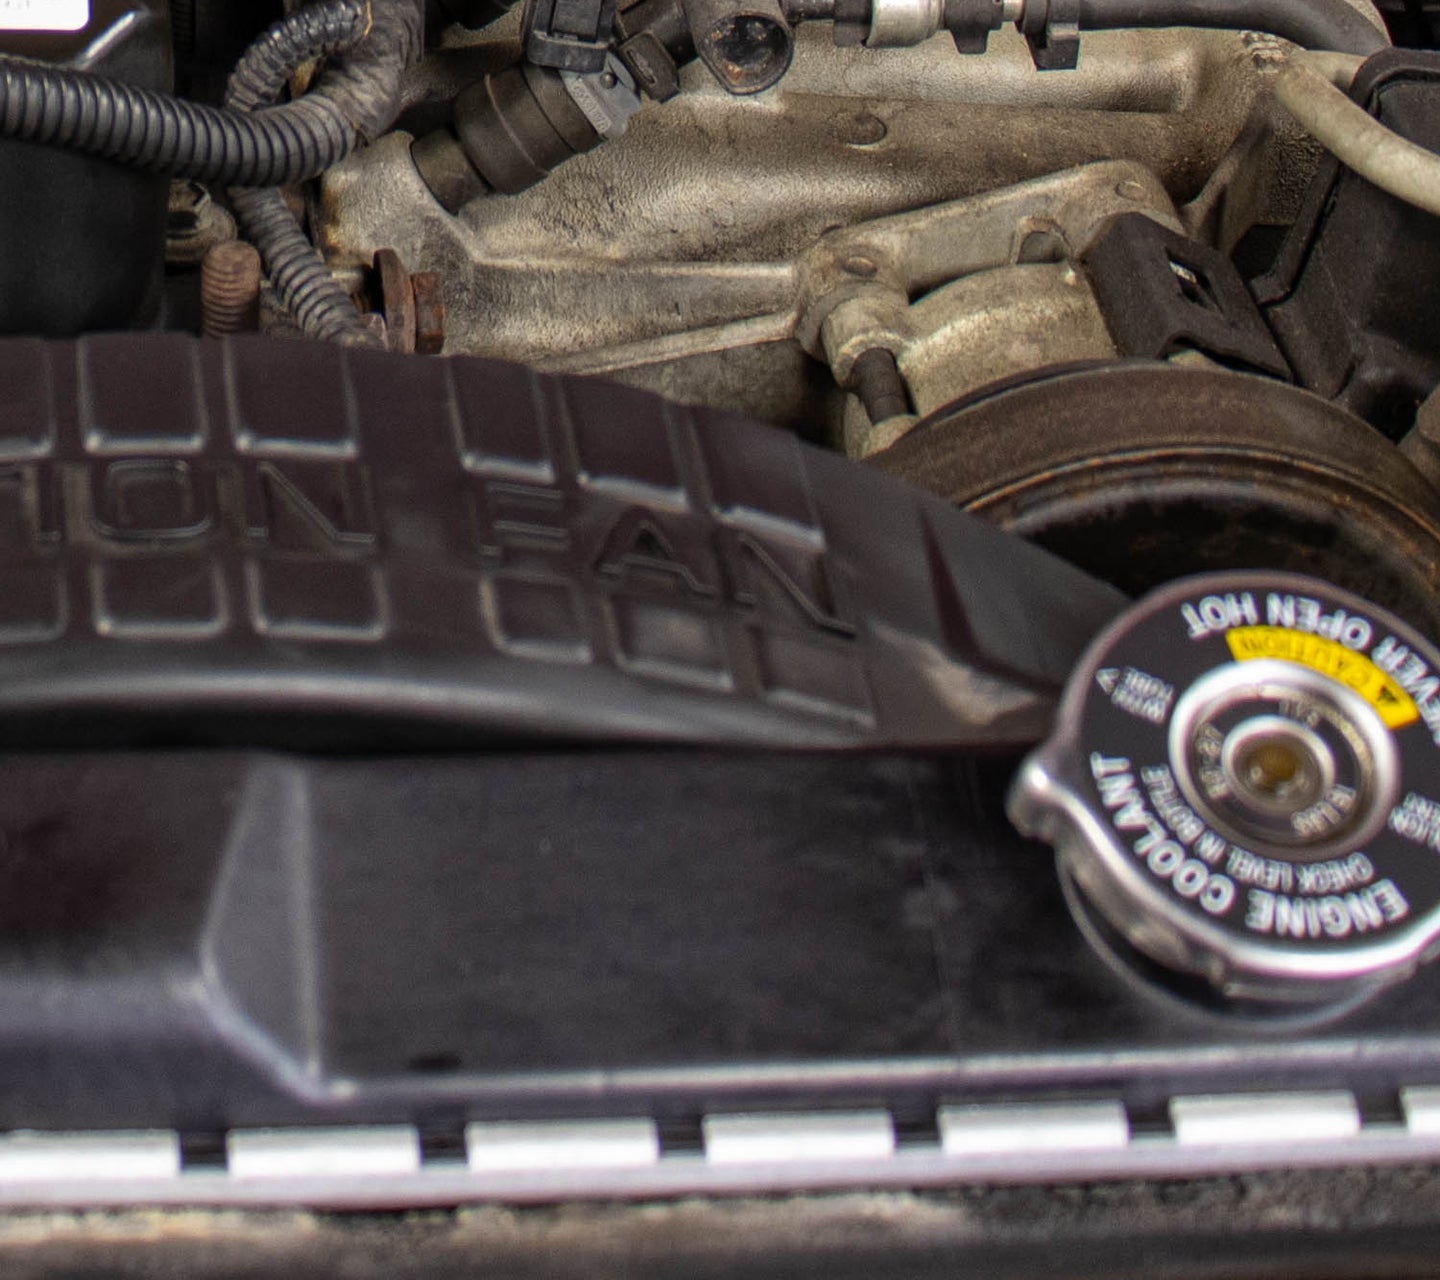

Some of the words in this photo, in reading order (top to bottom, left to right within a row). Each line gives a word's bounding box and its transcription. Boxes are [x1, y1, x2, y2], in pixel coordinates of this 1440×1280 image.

[474, 478, 862, 640] FAN
[1180, 592, 1260, 643] HOT
[1265, 593, 1376, 651] OPEN
[1240, 634, 1373, 690] CAUTION
[1087, 750, 1236, 914] COOLANT
[1139, 762, 1206, 847] BOTTLE
[1192, 827, 1226, 866] IN
[1224, 843, 1293, 894] LEVEL
[1295, 850, 1375, 895] CHECK
[1245, 877, 1410, 938] ENGINE
